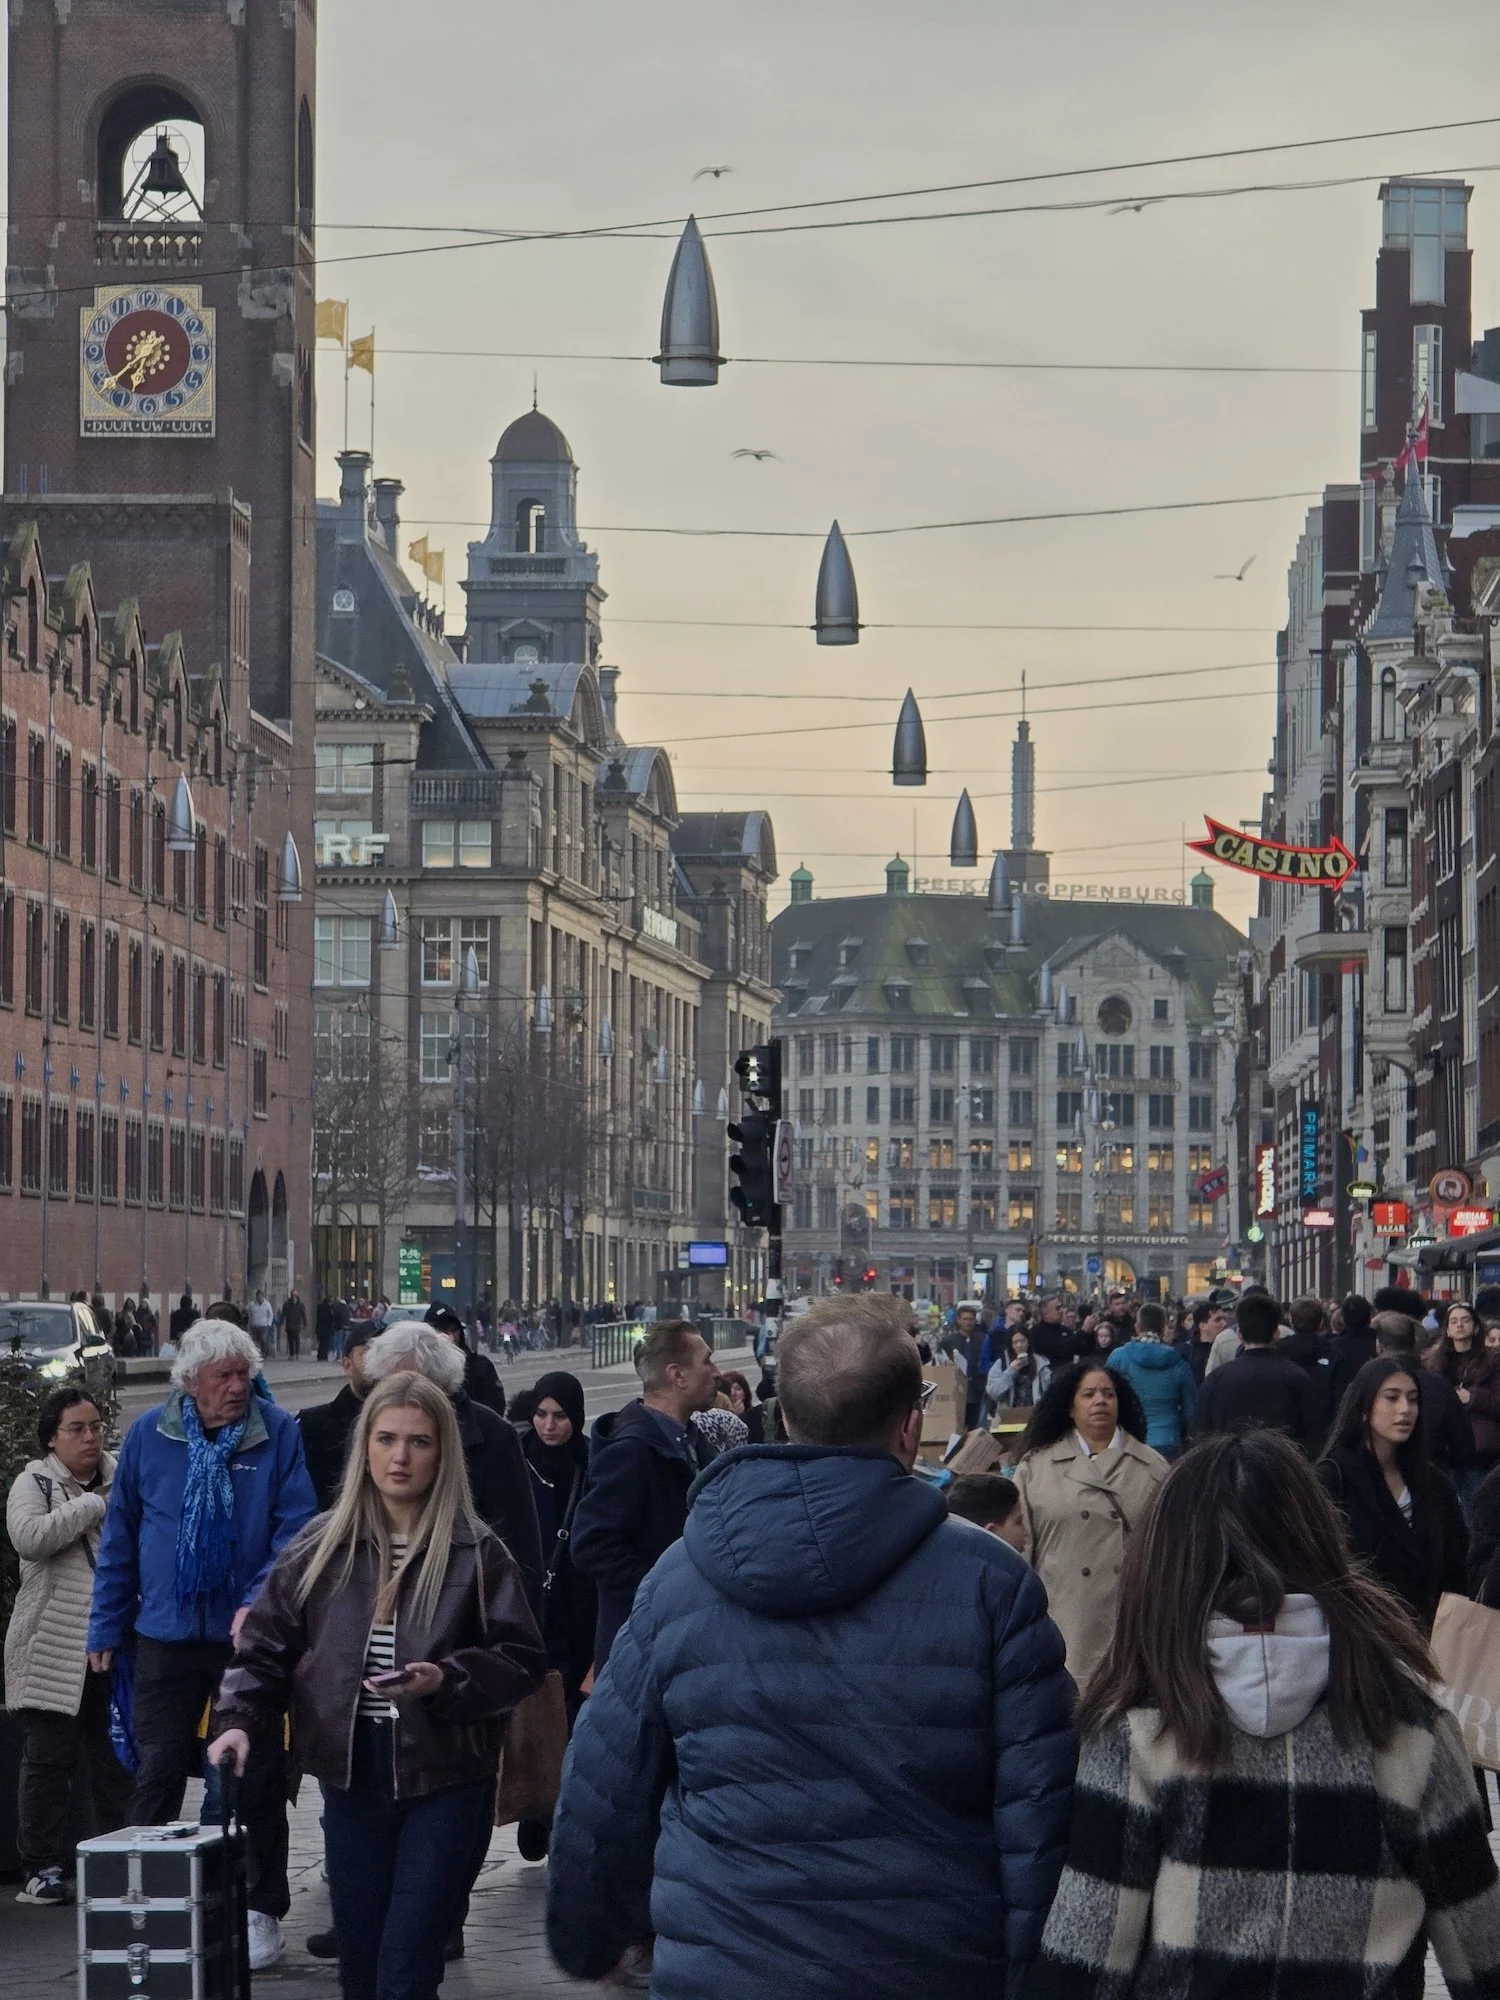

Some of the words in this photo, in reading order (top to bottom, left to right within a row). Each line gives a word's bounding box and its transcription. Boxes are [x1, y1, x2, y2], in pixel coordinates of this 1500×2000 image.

[141, 291, 155, 306] 12
[116, 299, 127, 314] 11
[97, 318, 109, 334] 10
[189, 318, 200, 334] 2
[89, 345, 99, 360] 9
[196, 345, 206, 360] 3
[189, 372, 199, 387] 4
[116, 392, 126, 407] 7
[170, 391, 180, 406] 5
[143, 399, 154, 414] 6
[1214, 833, 1349, 878] CASINO
[915, 877, 977, 893] PEEK
[1303, 1111, 1316, 1196] PRIMARK
[1456, 1211, 1487, 1221] INDIAN
[1376, 1224, 1406, 1233] BAZAR
